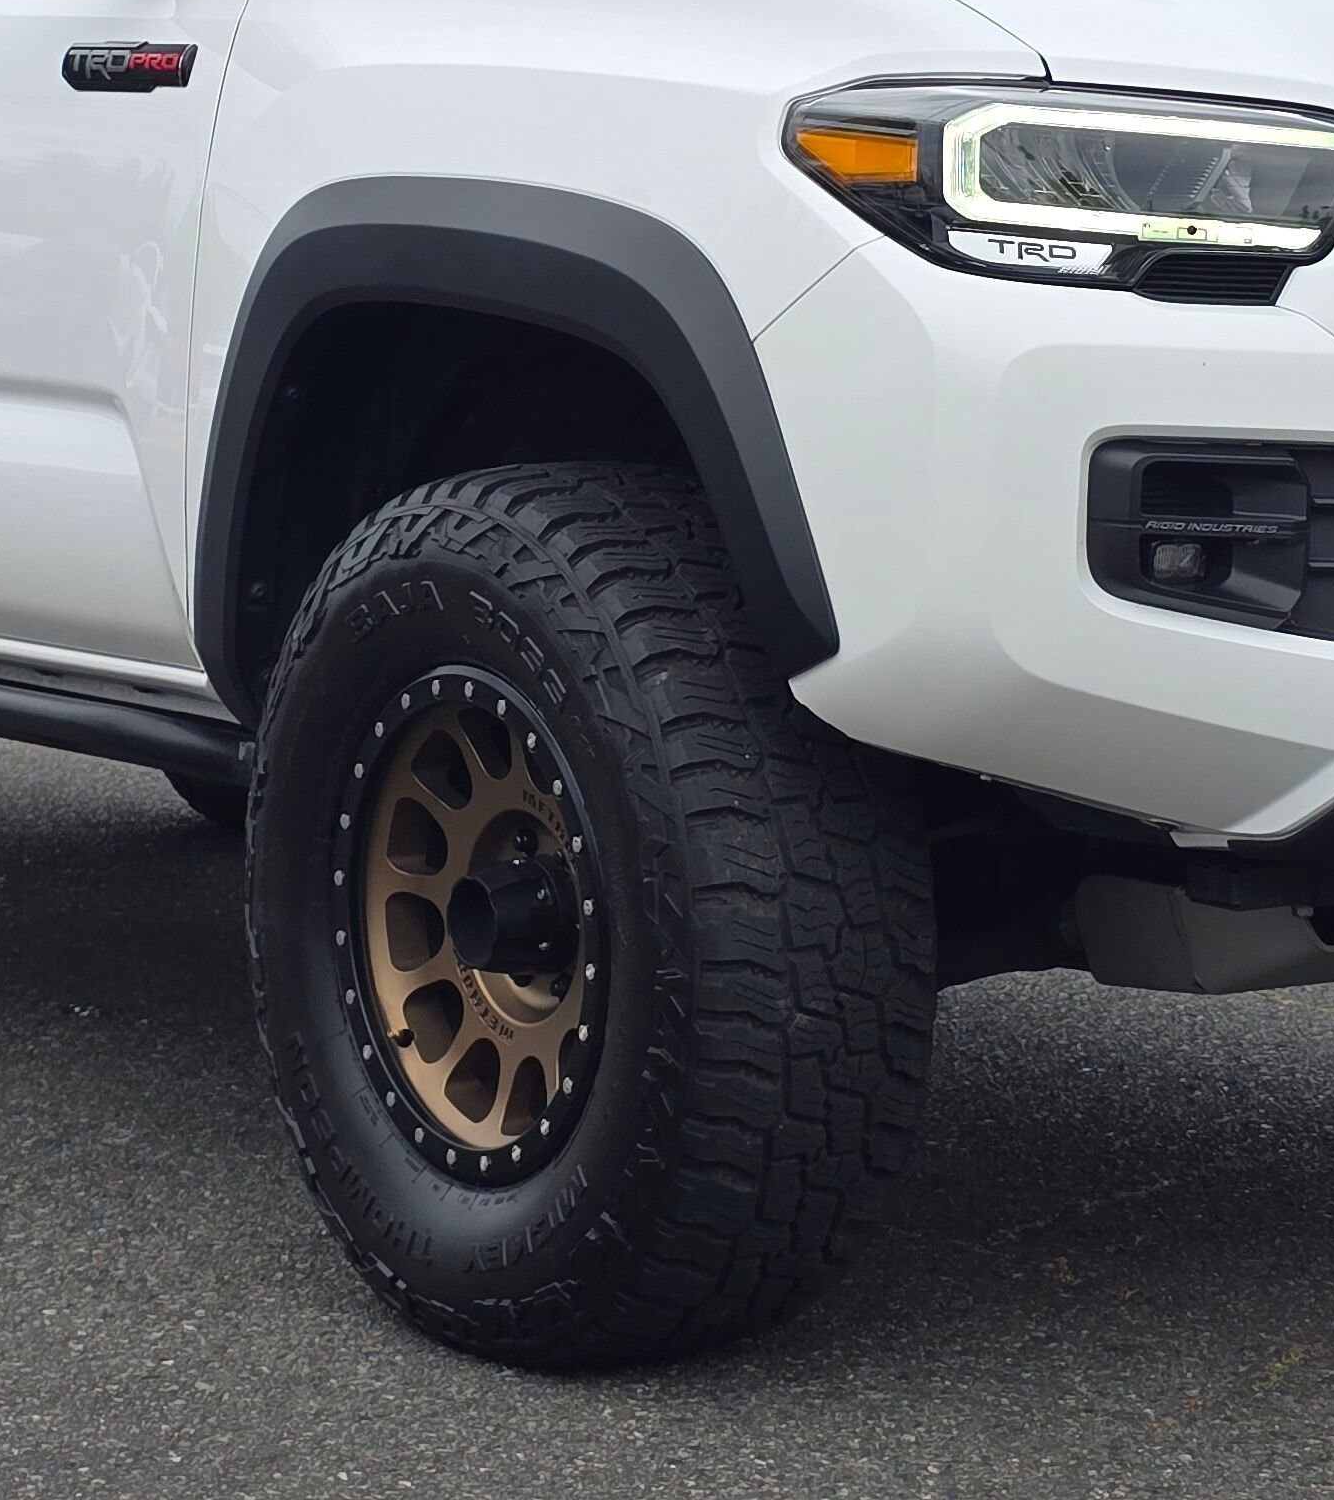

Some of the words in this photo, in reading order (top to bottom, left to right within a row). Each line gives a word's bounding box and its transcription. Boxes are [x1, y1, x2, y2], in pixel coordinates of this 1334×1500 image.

[69, 49, 132, 81] TRD
[129, 52, 180, 70] PRO
[987, 238, 1077, 262] TRD
[1144, 520, 1186, 531] RIGID
[1187, 521, 1279, 534] INDUSTRIES
